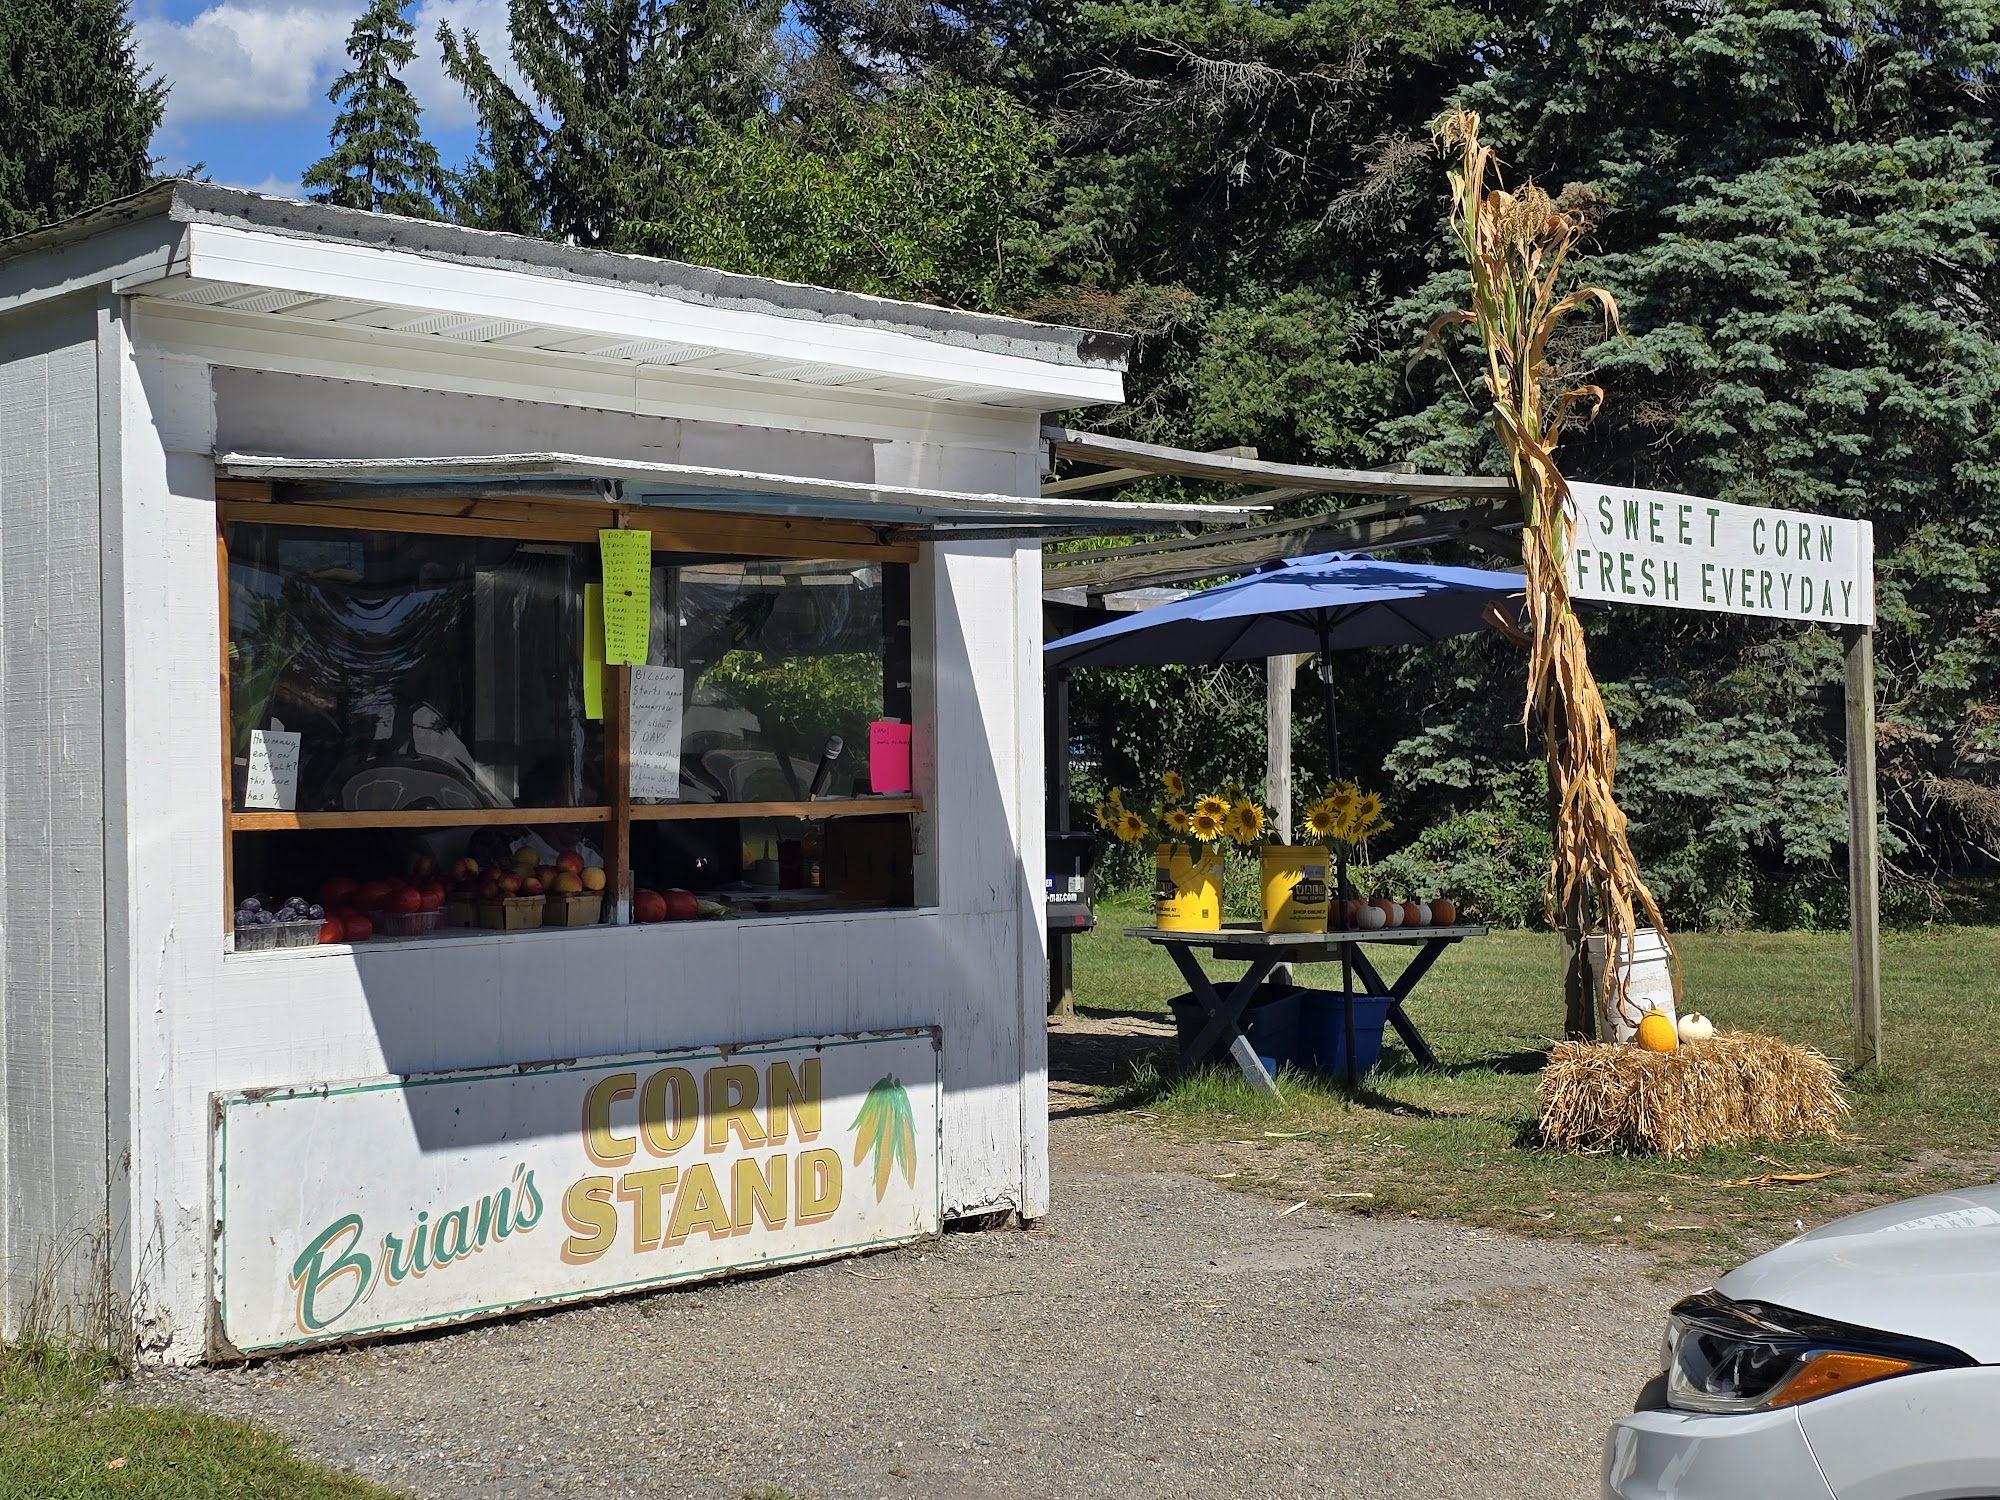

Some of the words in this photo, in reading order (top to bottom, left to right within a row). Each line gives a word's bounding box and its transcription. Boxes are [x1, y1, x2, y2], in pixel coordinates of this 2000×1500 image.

[1598, 494, 1720, 547] SWEET
[1752, 517, 1833, 562] CORN
[1576, 549, 1679, 601] FRESH
[1701, 563, 1853, 617] EVERYDAY
[642, 730, 667, 744] DAYS
[1296, 884, 1325, 895] VALU
[581, 1057, 822, 1168] CORN
[560, 1147, 843, 1266] STAND
[288, 1162, 544, 1335] Brian's
